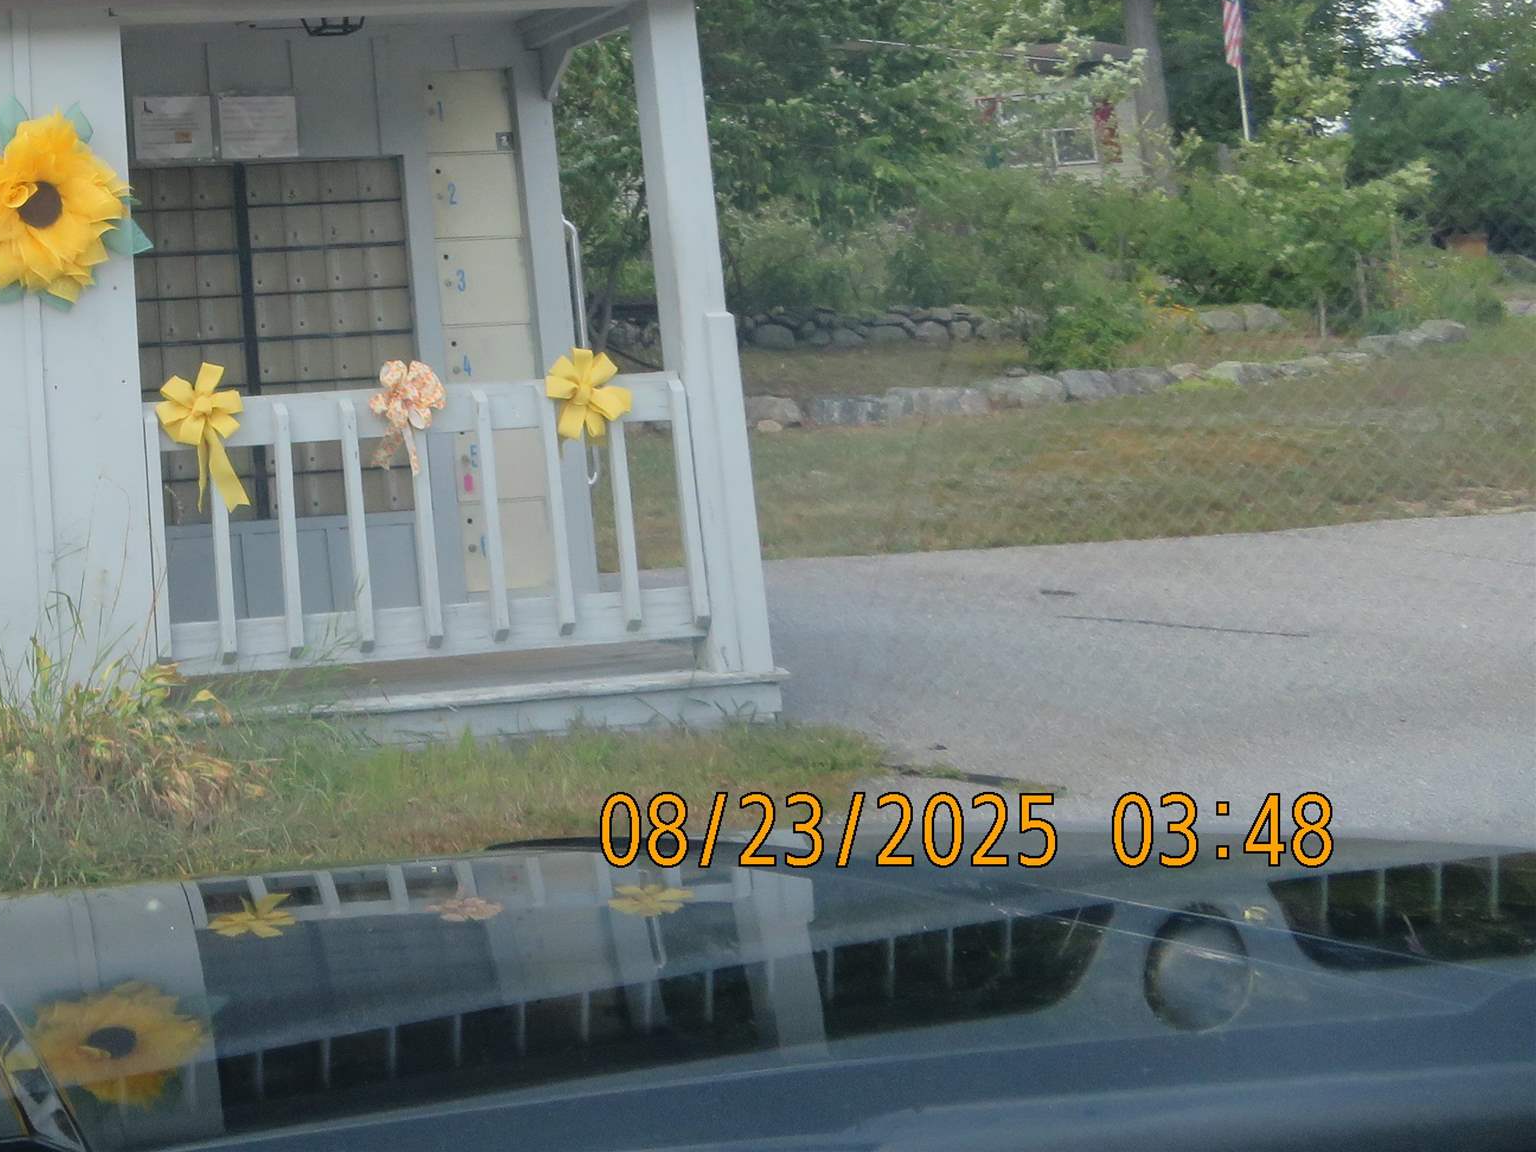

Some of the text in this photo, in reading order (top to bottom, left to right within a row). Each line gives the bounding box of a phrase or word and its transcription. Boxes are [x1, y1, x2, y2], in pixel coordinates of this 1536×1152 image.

[447, 182, 457, 205] 2
[456, 268, 466, 292] 3
[463, 354, 472, 377] 4
